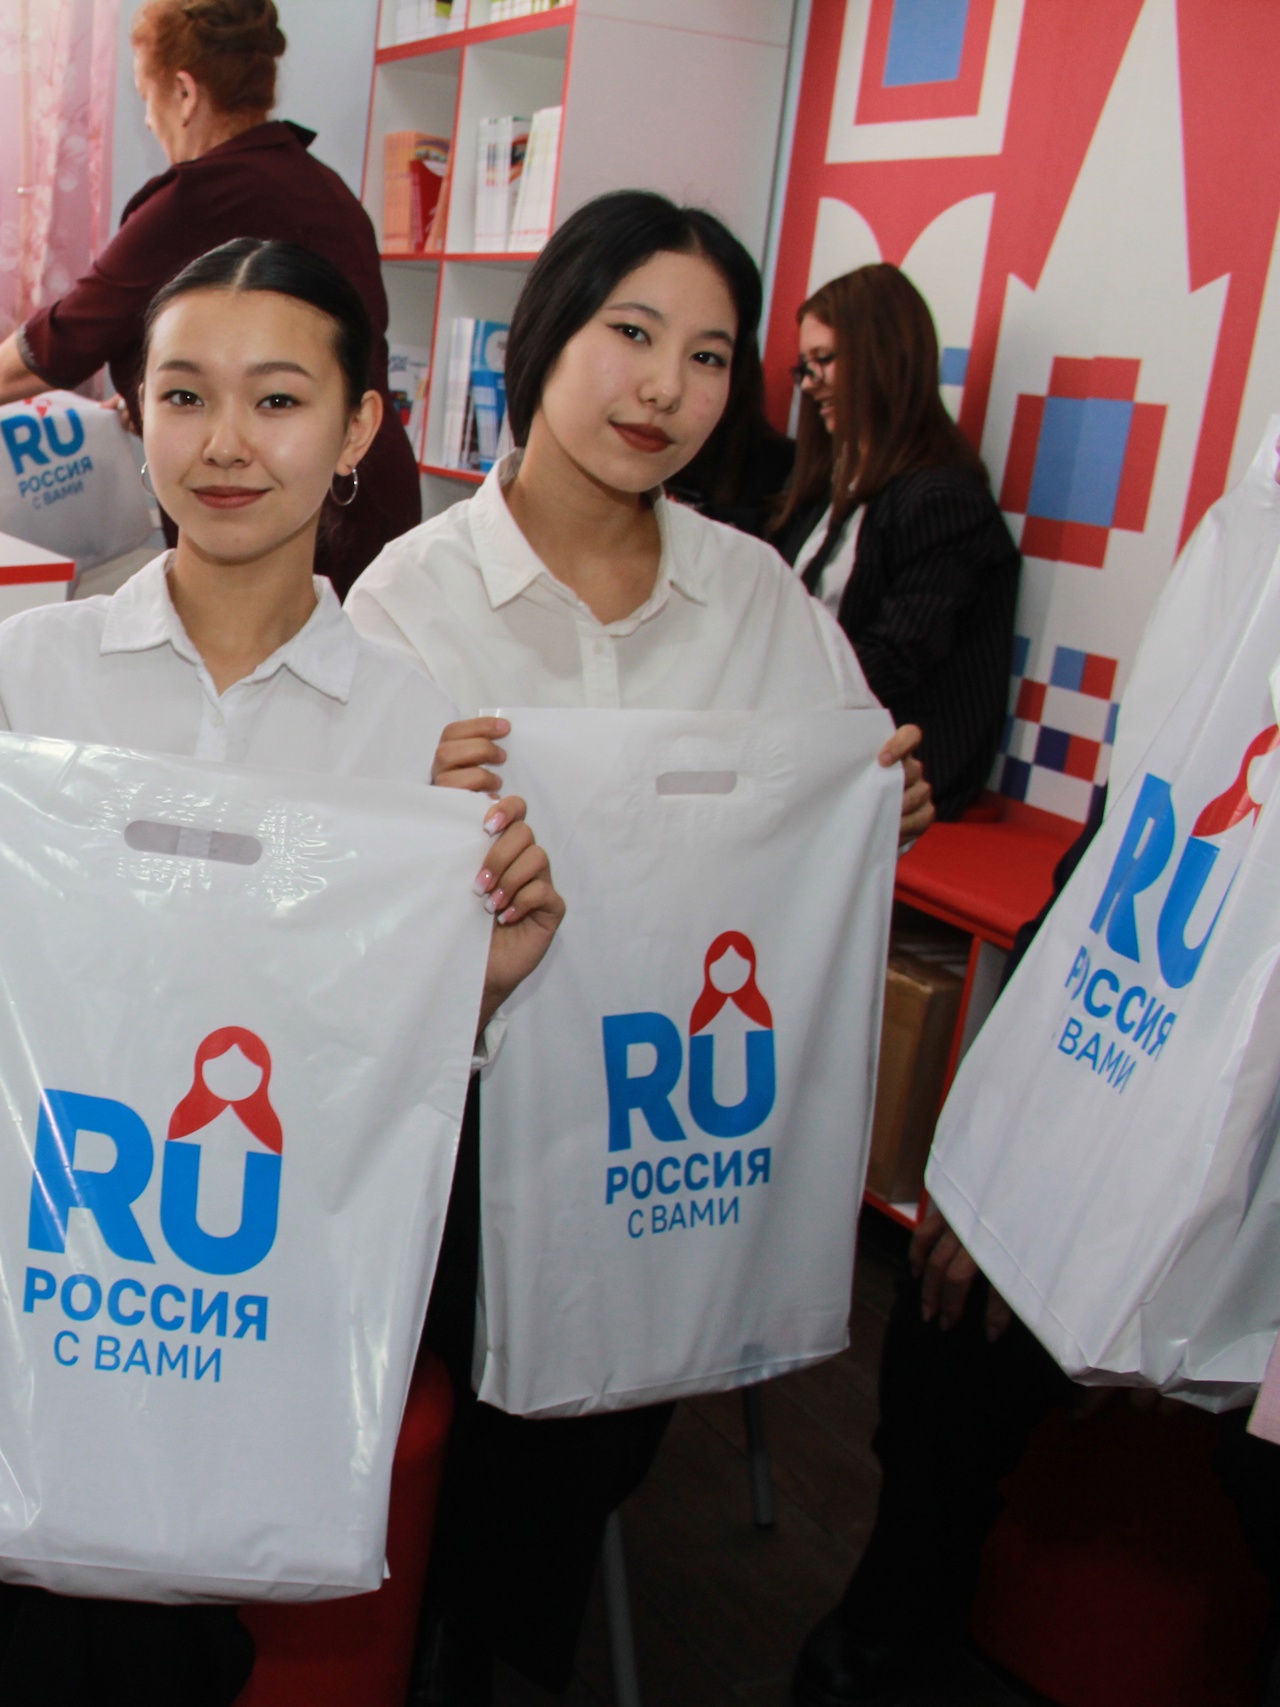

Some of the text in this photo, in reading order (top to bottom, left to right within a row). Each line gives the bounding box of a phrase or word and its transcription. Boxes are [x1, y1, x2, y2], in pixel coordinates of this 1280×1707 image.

[0, 408, 85, 475] RU
[18, 455, 93, 497] РОССИЯ
[32, 480, 84, 510] С ВАМИ
[1089, 772, 1242, 990] RU
[601, 1011, 778, 1154] RU
[1057, 1016, 1137, 1095] ВАМИ
[27, 1088, 284, 1277] RU
[605, 1146, 773, 1206] РОССИЯ
[627, 1195, 740, 1240] С ВАМИ
[22, 1266, 270, 1343] РОССИЯ
[53, 1330, 223, 1384] С ВАМИ
